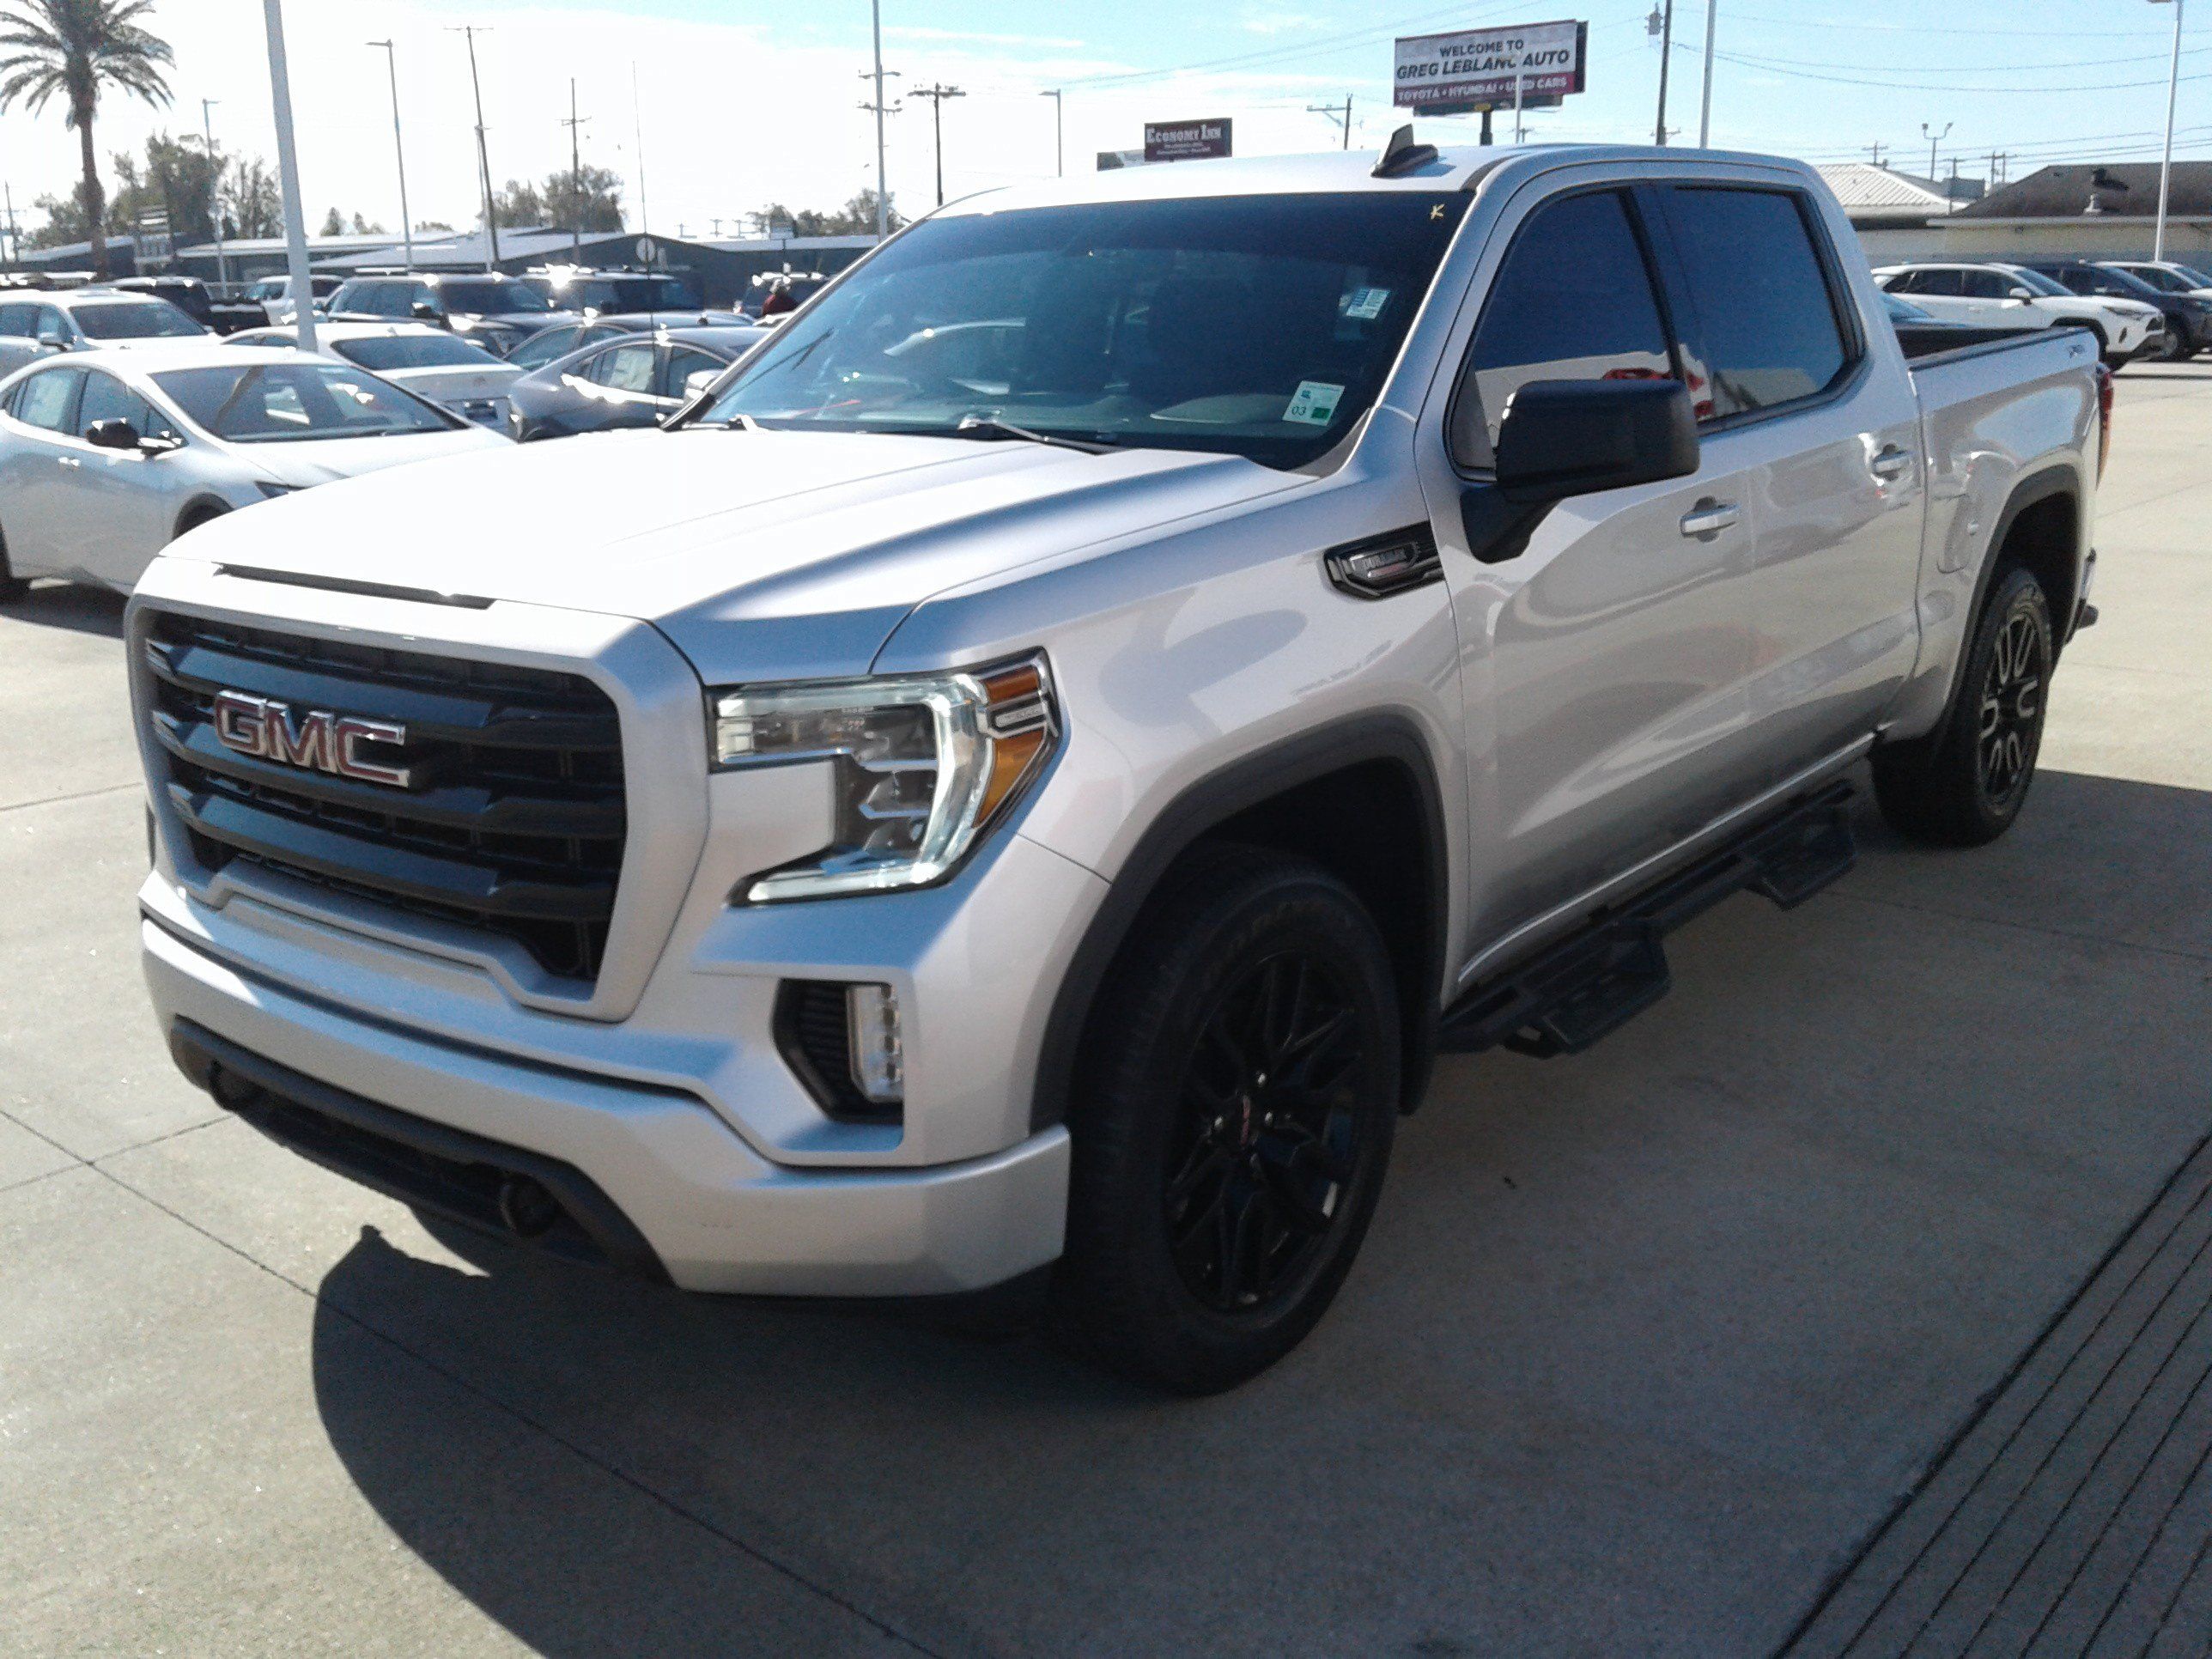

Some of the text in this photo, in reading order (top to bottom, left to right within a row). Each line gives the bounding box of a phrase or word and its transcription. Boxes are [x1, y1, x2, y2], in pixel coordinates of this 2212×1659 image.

[1440, 39, 1524, 58] WELCOME TO
[1397, 63, 1438, 79] GREG
[1522, 49, 1570, 67] AUTO
[1397, 76, 1567, 101] TOYOTA HYUNDAI UED CARS
[216, 690, 410, 788] GMC
